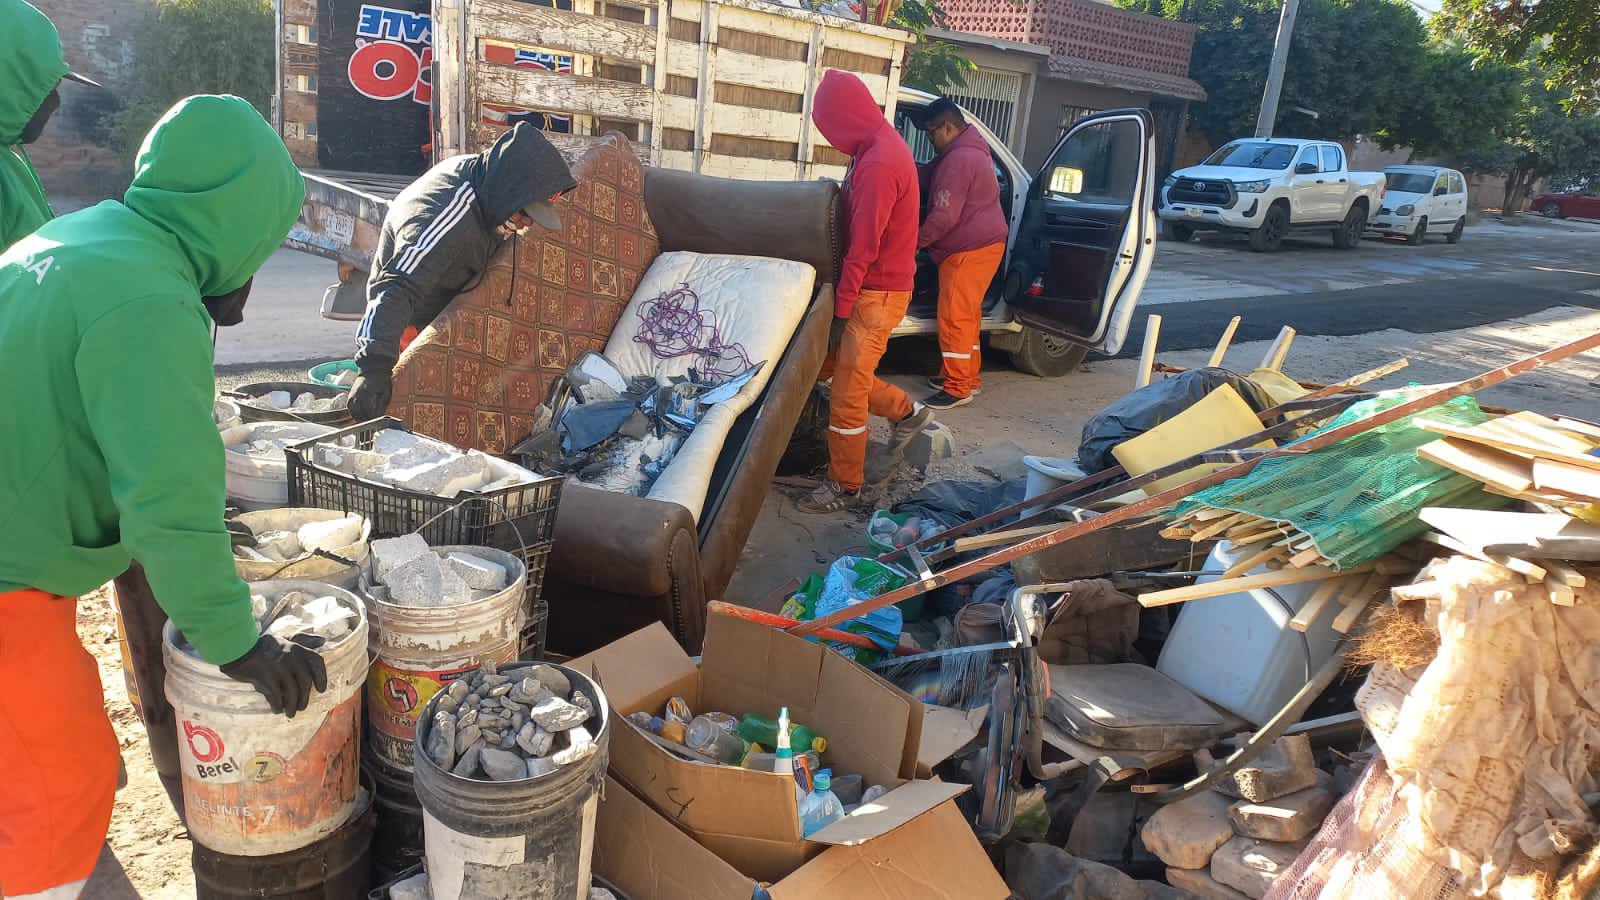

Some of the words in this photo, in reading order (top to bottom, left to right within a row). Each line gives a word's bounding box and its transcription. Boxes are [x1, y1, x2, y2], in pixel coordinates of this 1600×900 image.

[356, 4, 432, 45] ALE
[196, 756, 240, 779] Berel
[258, 804, 276, 827] 7
